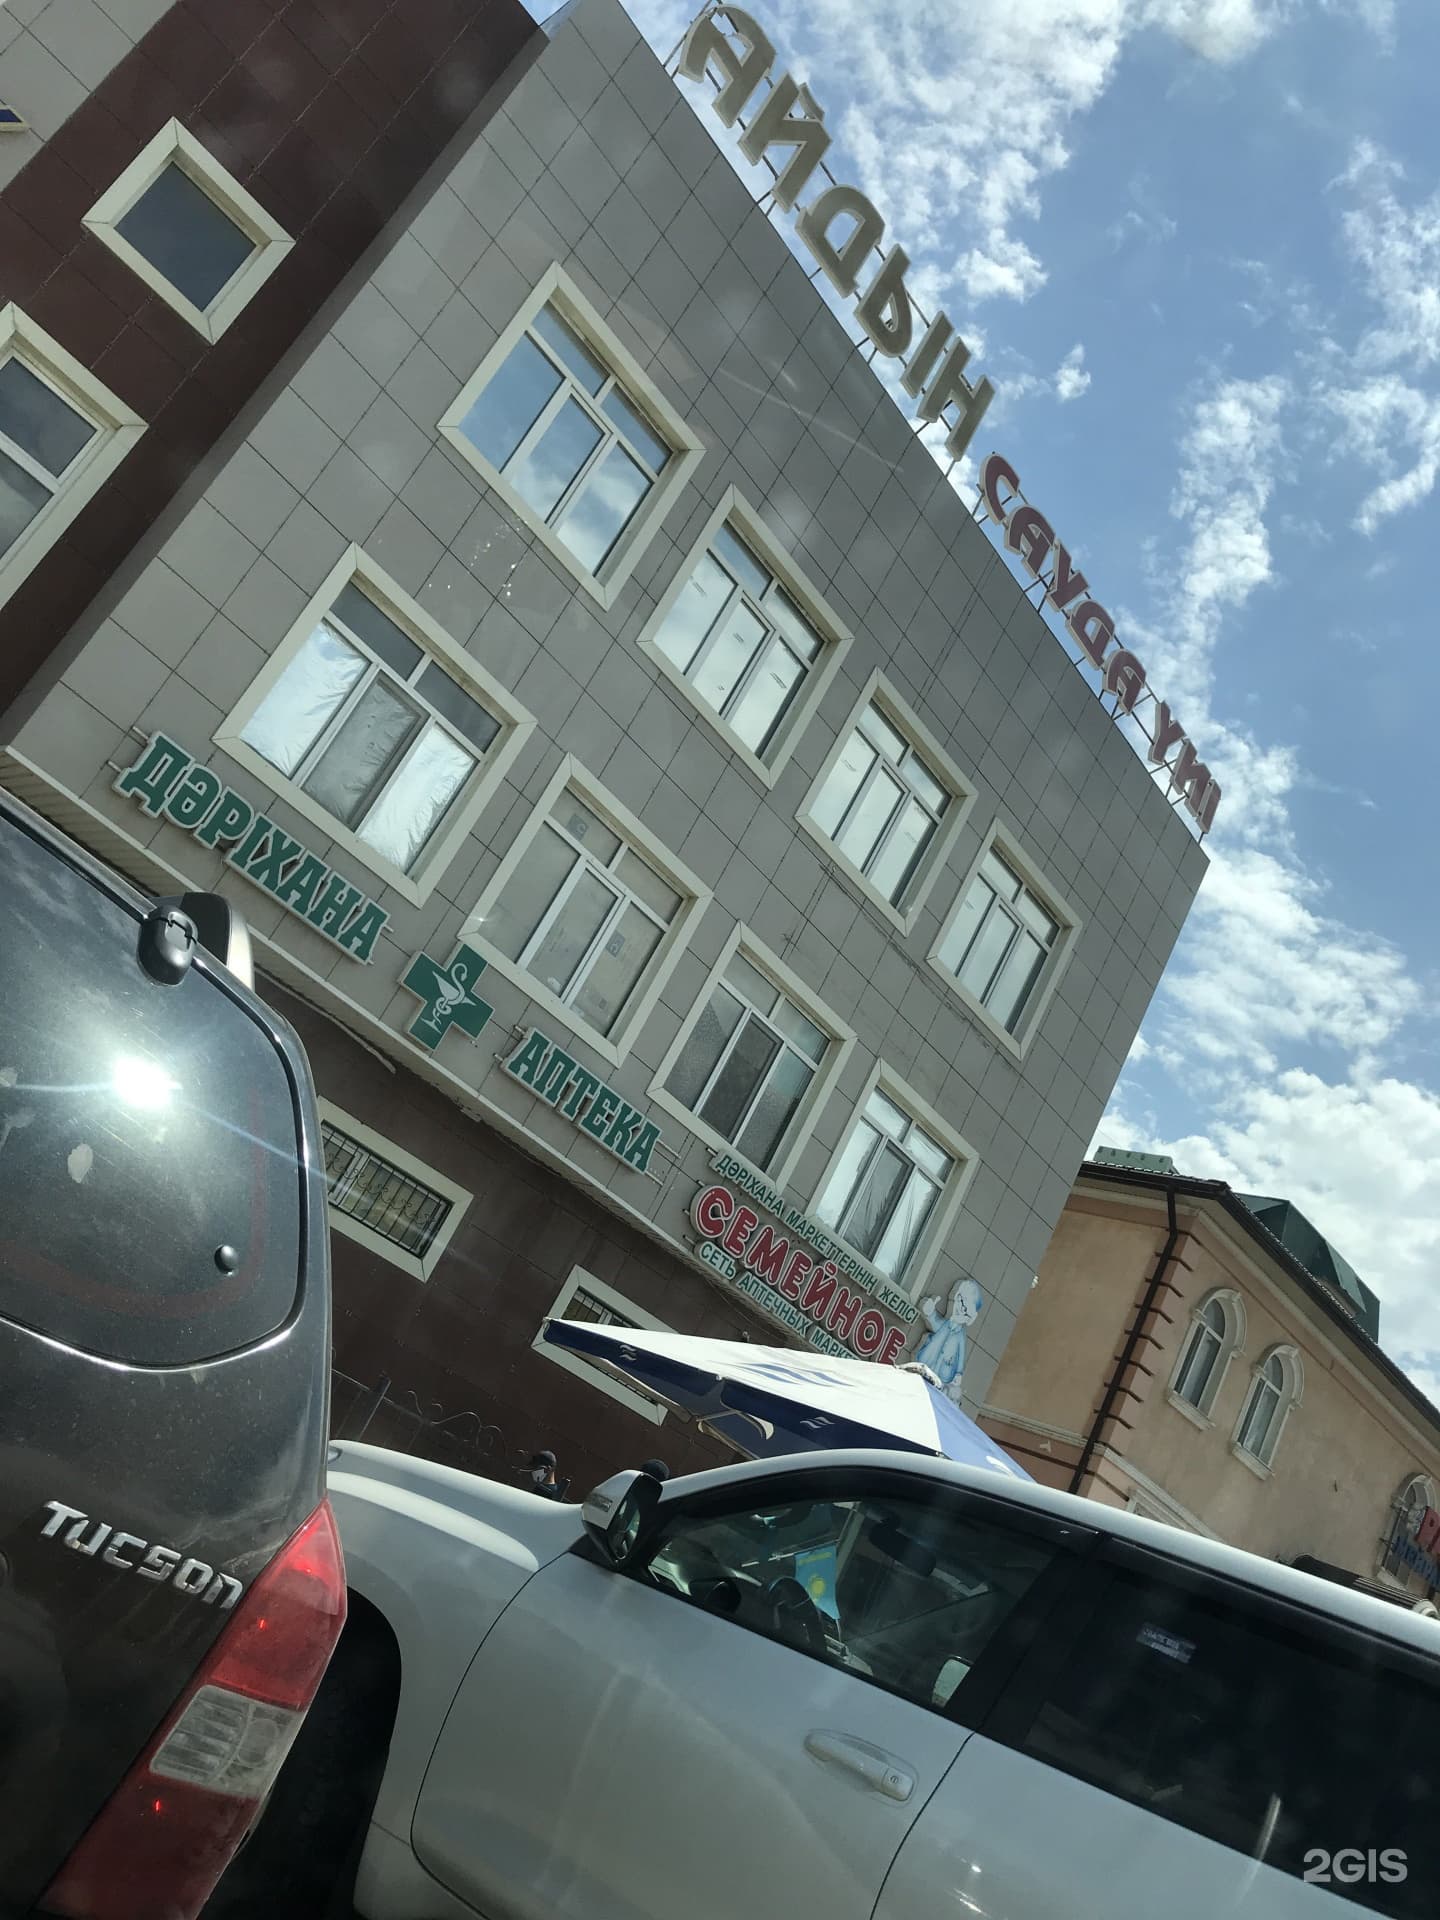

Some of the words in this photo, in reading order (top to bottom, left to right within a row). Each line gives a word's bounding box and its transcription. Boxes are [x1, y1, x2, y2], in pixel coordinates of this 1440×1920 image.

[679, 3, 996, 462] АЙДЫН
[978, 451, 1147, 716] САУДА
[116, 733, 390, 964] ДӘРІХАНА
[506, 1031, 664, 1173] АПТЕКА
[695, 1185, 907, 1365] СЕМЕЙНОЕ
[700, 1242, 736, 1279] СЕТЬ
[737, 1273, 812, 1337] АПТЕЧНЫХ
[714, 1154, 784, 1216] ДӘРІХАНА
[878, 1286, 920, 1324] ЖЕЛІСІ
[40, 1499, 244, 1609] TUCSON
